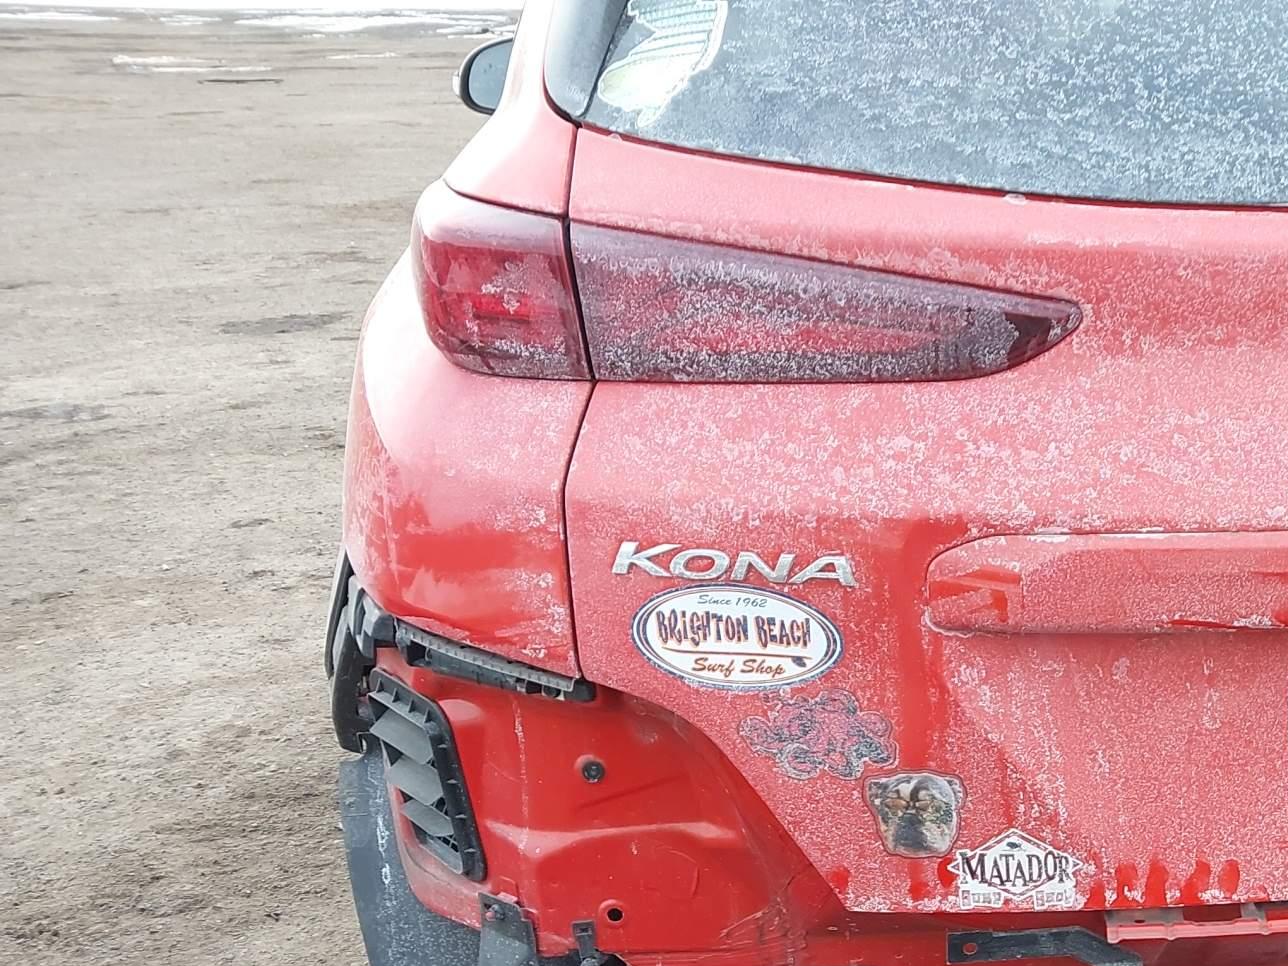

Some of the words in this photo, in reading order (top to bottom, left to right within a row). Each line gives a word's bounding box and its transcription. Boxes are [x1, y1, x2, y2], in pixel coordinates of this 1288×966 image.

[612, 541, 857, 587] KONA
[697, 594, 732, 606] Since
[735, 596, 768, 608] 1962
[755, 615, 811, 648] BEACH
[692, 656, 734, 677] Surf
[740, 658, 786, 678] Shop
[960, 850, 1073, 887] MATADOR
